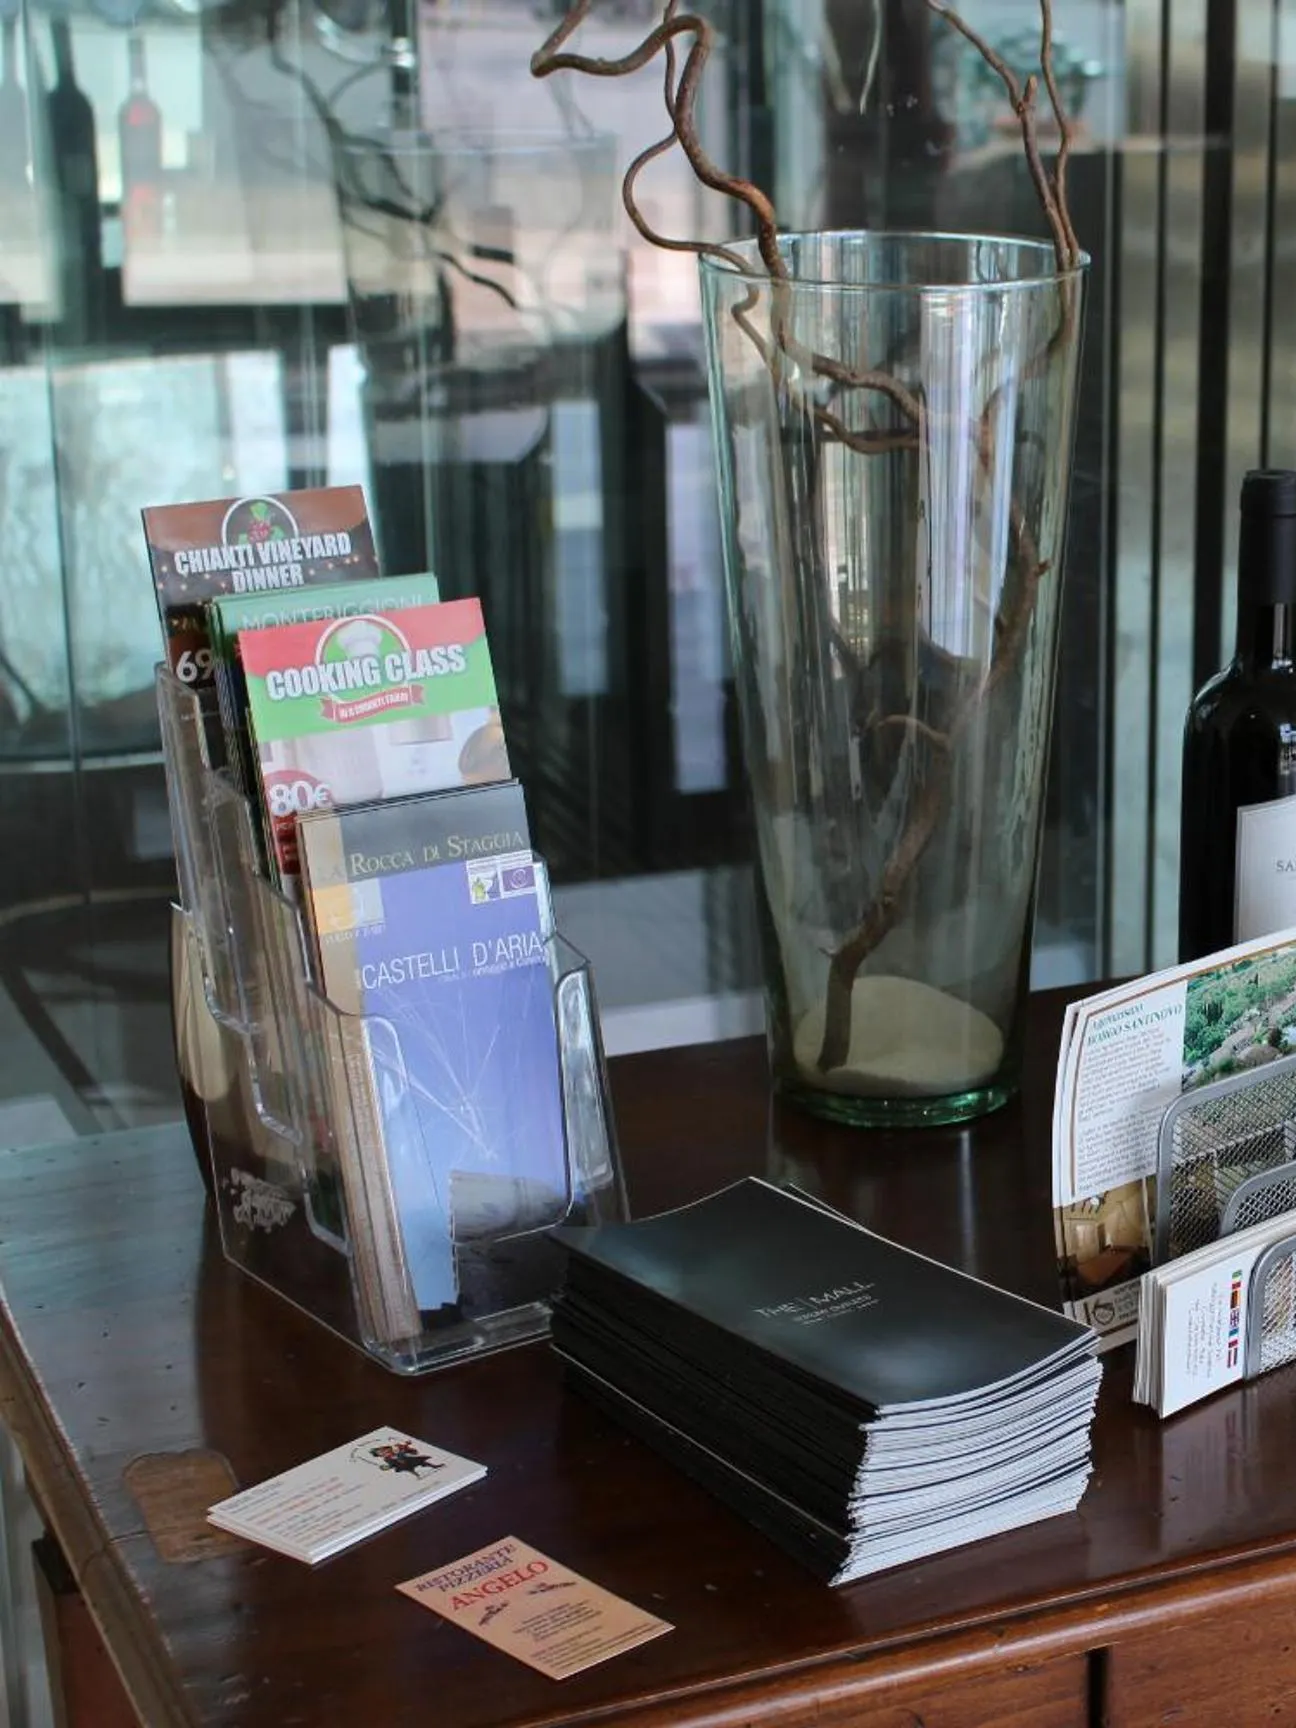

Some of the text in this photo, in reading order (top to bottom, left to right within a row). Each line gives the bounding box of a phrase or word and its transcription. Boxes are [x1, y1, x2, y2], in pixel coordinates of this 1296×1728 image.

[174, 532, 352, 577] CHIANTI VINEYARD
[232, 564, 304, 593] DINNER
[266, 644, 466, 700] COOKING CLASS
[269, 779, 332, 817] 80€
[352, 851, 415, 876] ROCCA
[424, 848, 441, 863] DI
[447, 831, 525, 858] STAGGIA
[362, 946, 459, 990] CASTELLI
[752, 1301, 805, 1319] THE
[804, 1281, 876, 1309] MALL
[415, 1543, 516, 1593] RISTORANTE
[438, 1555, 514, 1593] PIZZERIA
[450, 1560, 549, 1611] ANGELO
